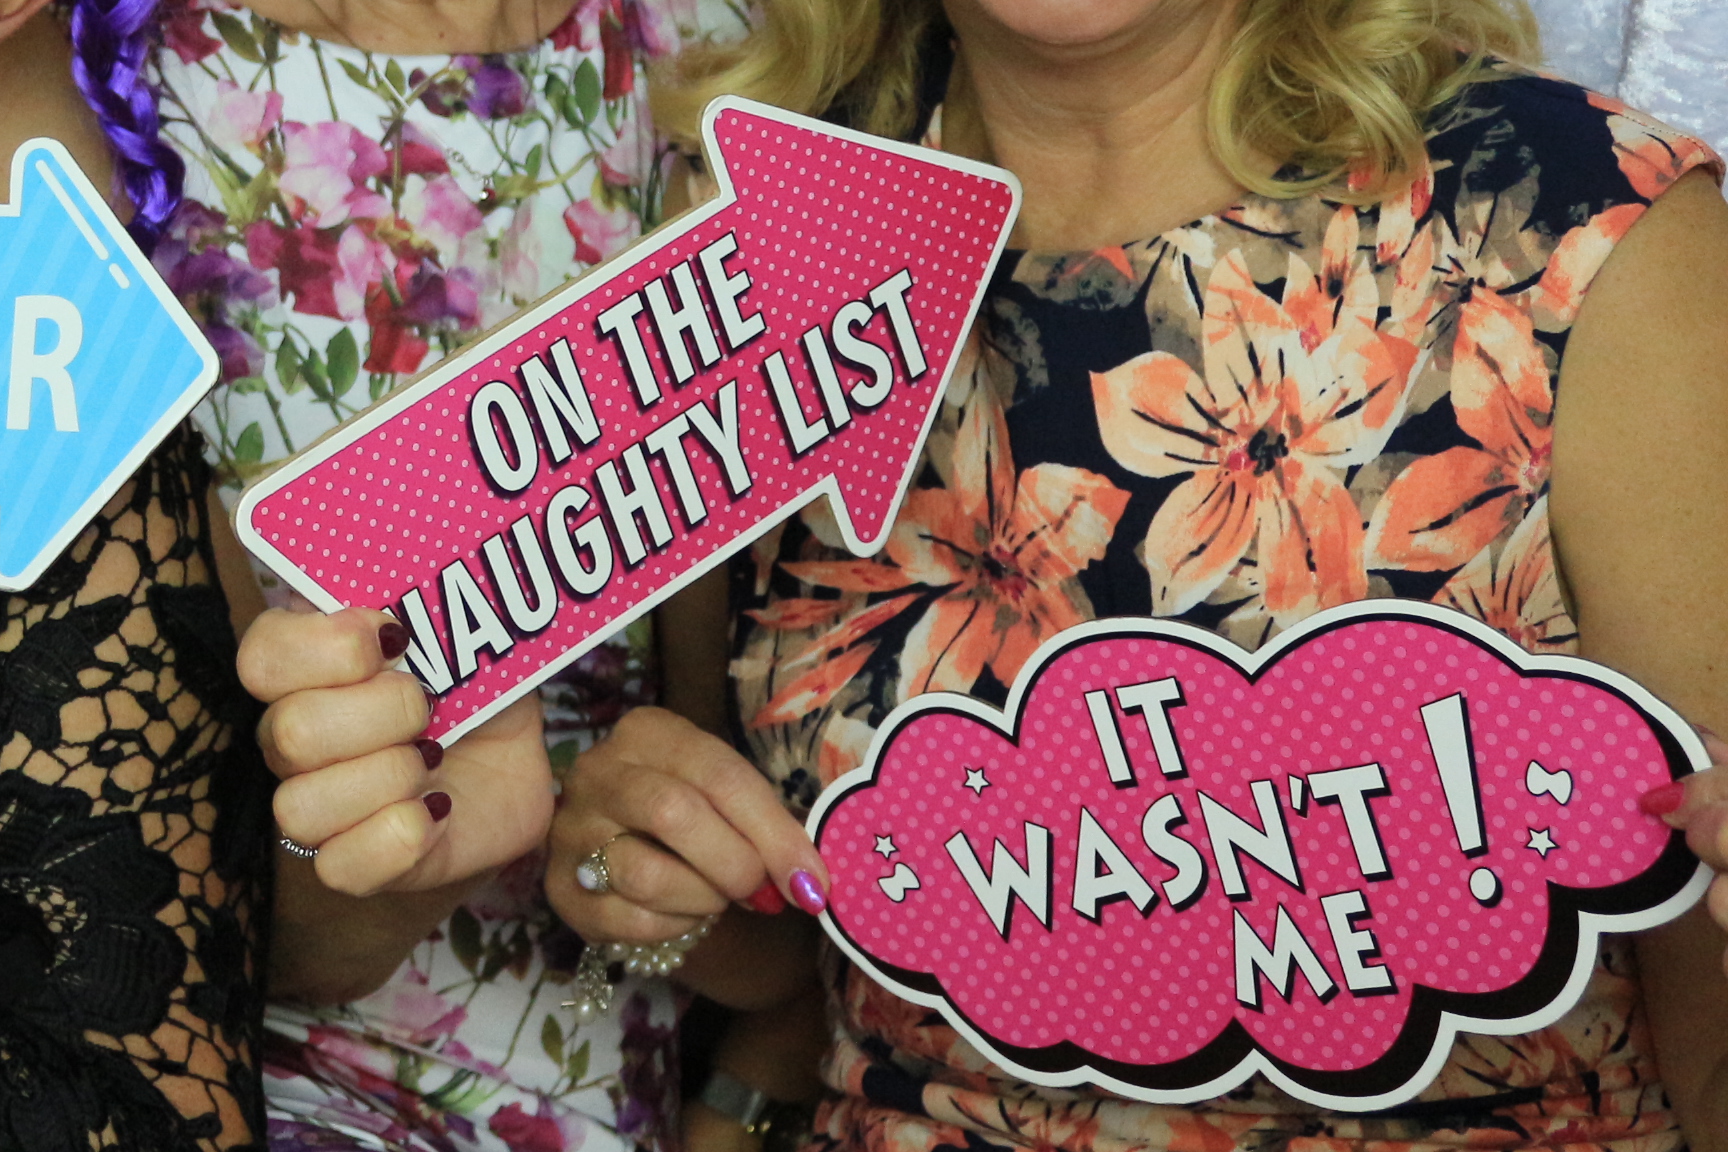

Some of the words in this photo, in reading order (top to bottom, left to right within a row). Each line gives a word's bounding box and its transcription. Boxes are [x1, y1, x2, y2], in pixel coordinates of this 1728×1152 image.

[469, 338, 602, 493] ON
[596, 232, 766, 407] THE
[381, 380, 754, 695] NAUGHTY
[764, 268, 928, 455] LIST
[1084, 677, 1185, 786] IT
[944, 762, 1389, 938] WASN'T
[1232, 890, 1395, 1008] ME
